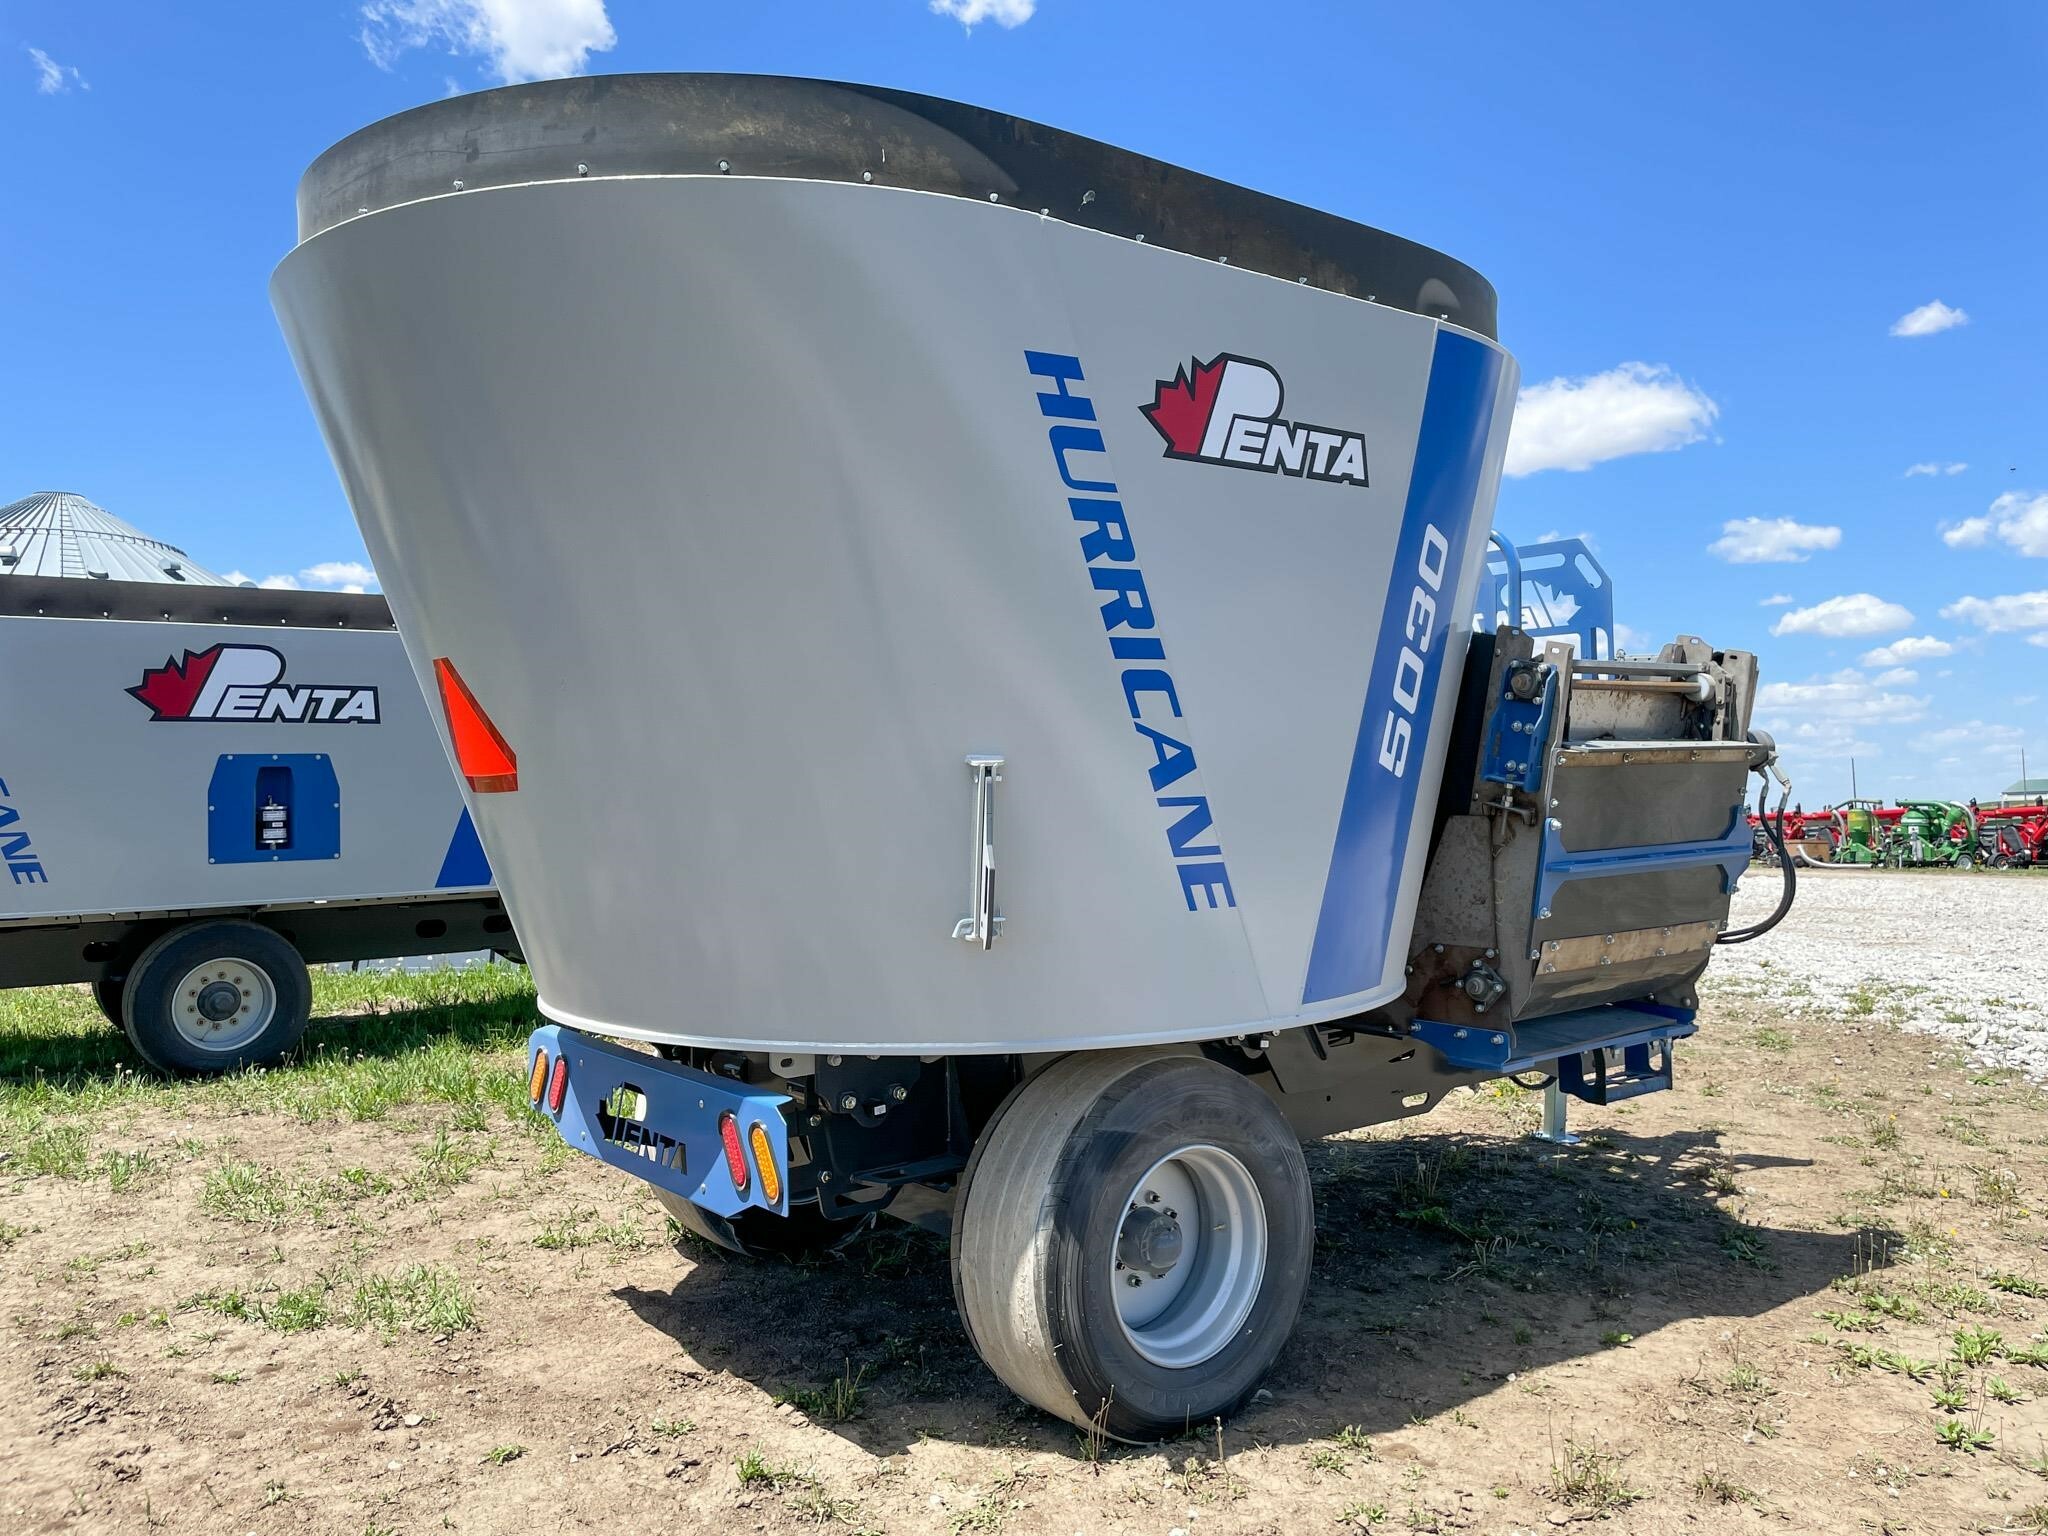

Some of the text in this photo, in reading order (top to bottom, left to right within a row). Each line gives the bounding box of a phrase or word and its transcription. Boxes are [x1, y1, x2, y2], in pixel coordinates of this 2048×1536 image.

[1198, 354, 1368, 486] PENTA
[187, 644, 380, 723] PENTA
[1024, 350, 1236, 912] HURRICANE
[1379, 523, 1448, 778] 5030
[0, 777, 48, 884] ANE
